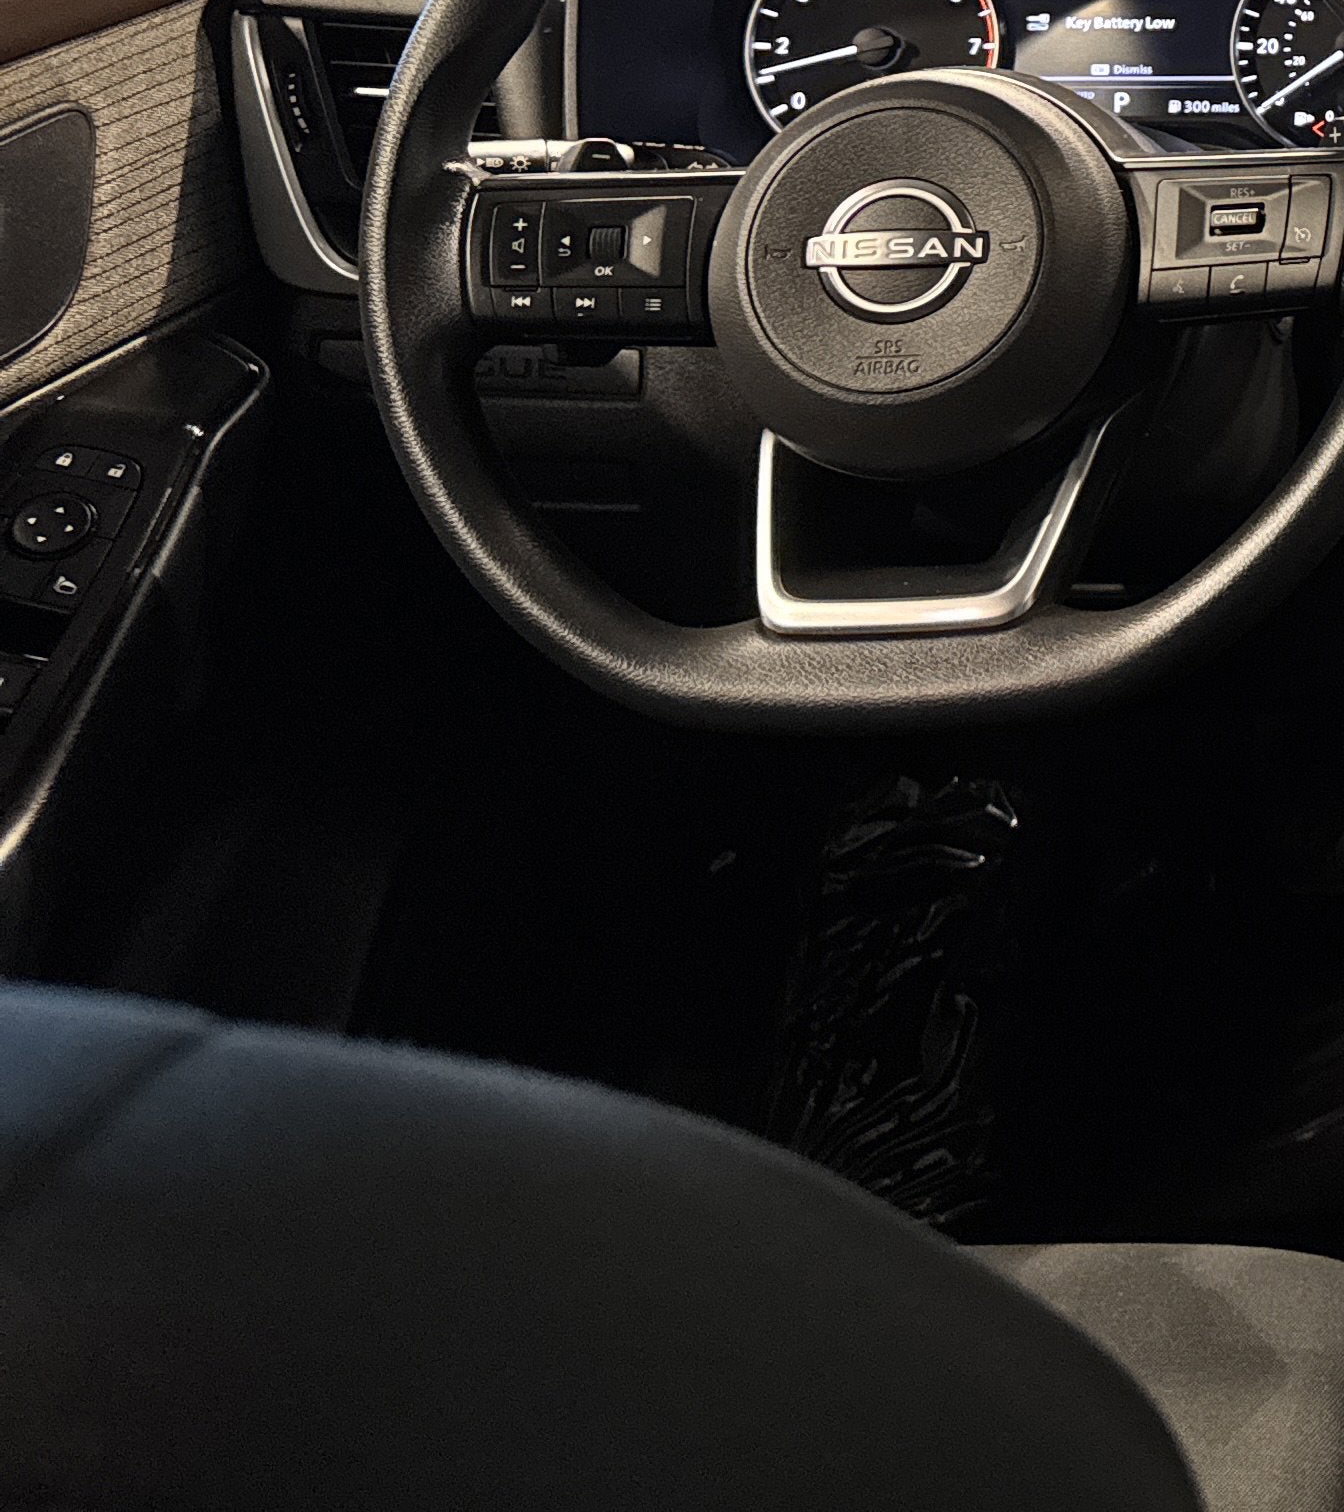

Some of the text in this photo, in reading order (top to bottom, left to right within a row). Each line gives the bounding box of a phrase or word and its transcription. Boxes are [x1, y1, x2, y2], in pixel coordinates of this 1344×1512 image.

[1065, 16, 1177, 32] Key Battery Low
[1300, 10, 1315, 22] 60
[774, 37, 790, 55] 2
[968, 38, 983, 56] 7
[1256, 38, 1280, 55] 20
[1292, 55, 1306, 67] 20
[1113, 64, 1154, 76] Dismiss
[789, 91, 807, 110] 0
[1113, 91, 1131, 114] P
[1183, 100, 1241, 114] 300 miles
[1213, 213, 1256, 225] CANCEL
[811, 237, 984, 264] NISSAN
[594, 266, 614, 277] OK
[874, 339, 903, 354] SRS
[853, 359, 921, 376] AIRBAG
